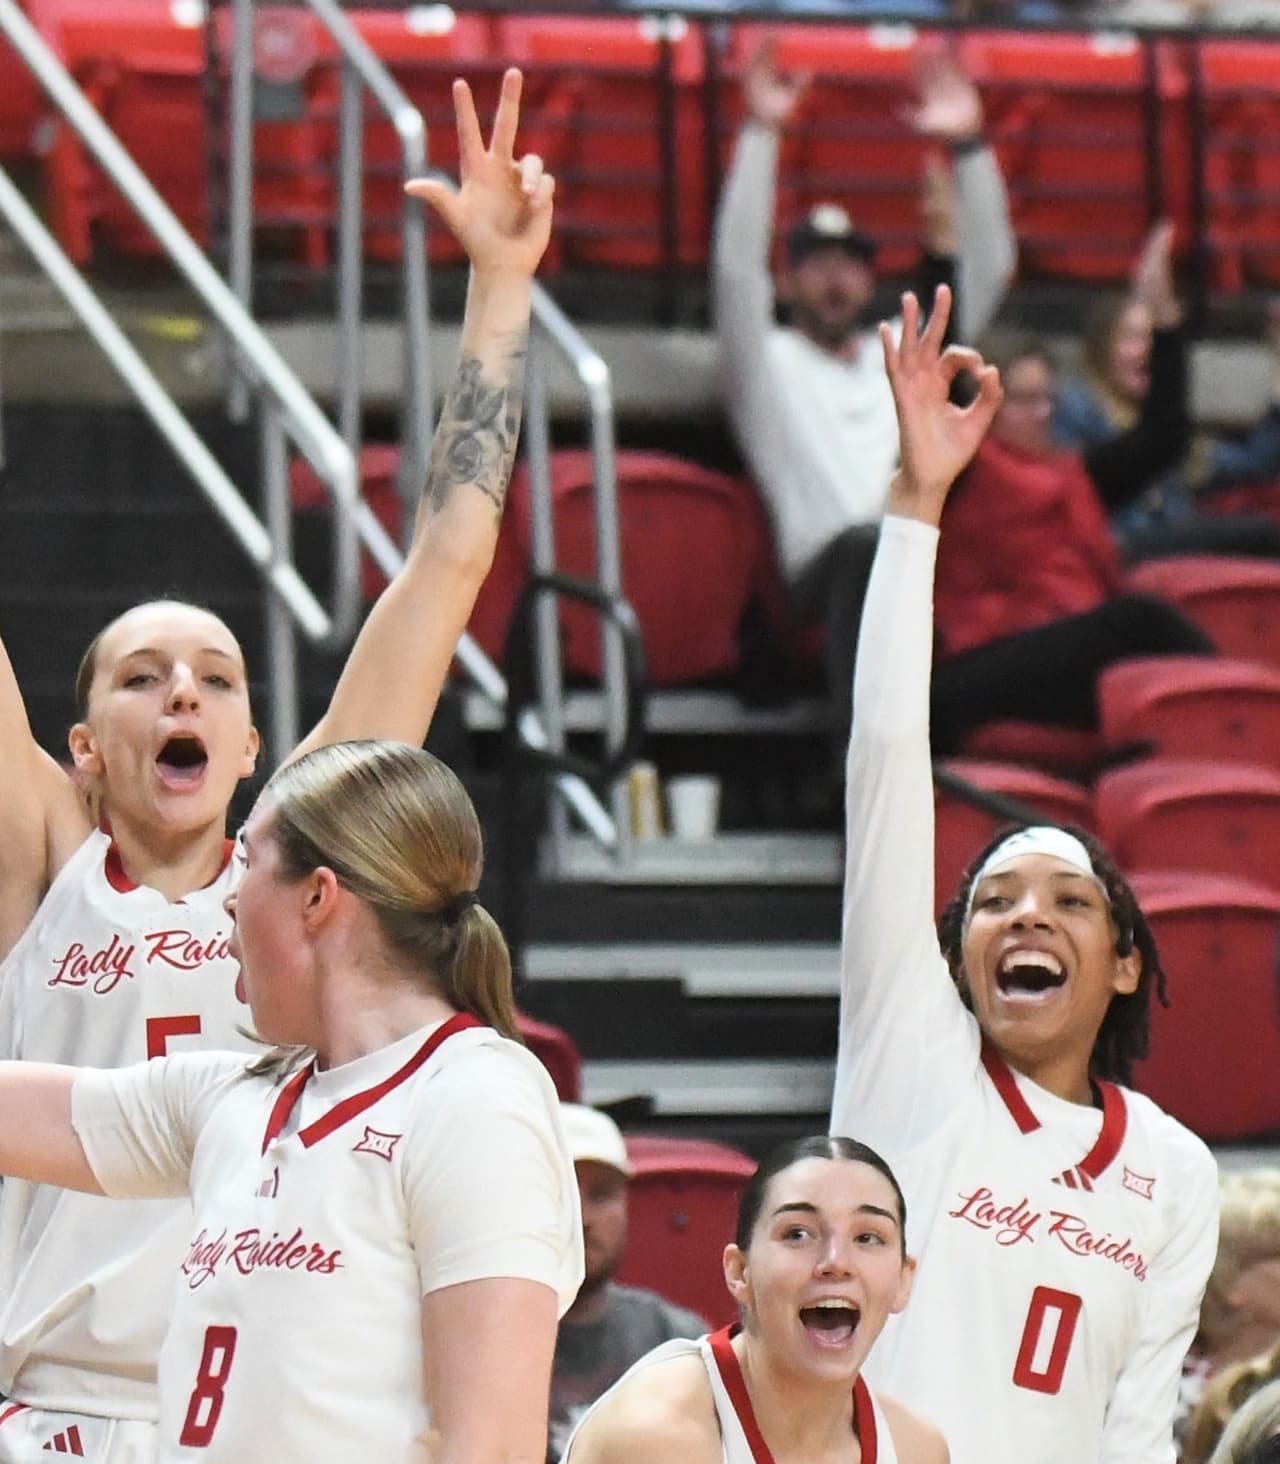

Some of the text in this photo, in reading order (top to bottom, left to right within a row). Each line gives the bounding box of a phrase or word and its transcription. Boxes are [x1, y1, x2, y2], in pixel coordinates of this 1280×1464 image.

[47, 933, 136, 994] Lady
[948, 1186, 1042, 1247] Lady
[180, 1227, 345, 1290] Lady Raiders
[1011, 1284, 1084, 1396] 0
[178, 1325, 238, 1448] 8
